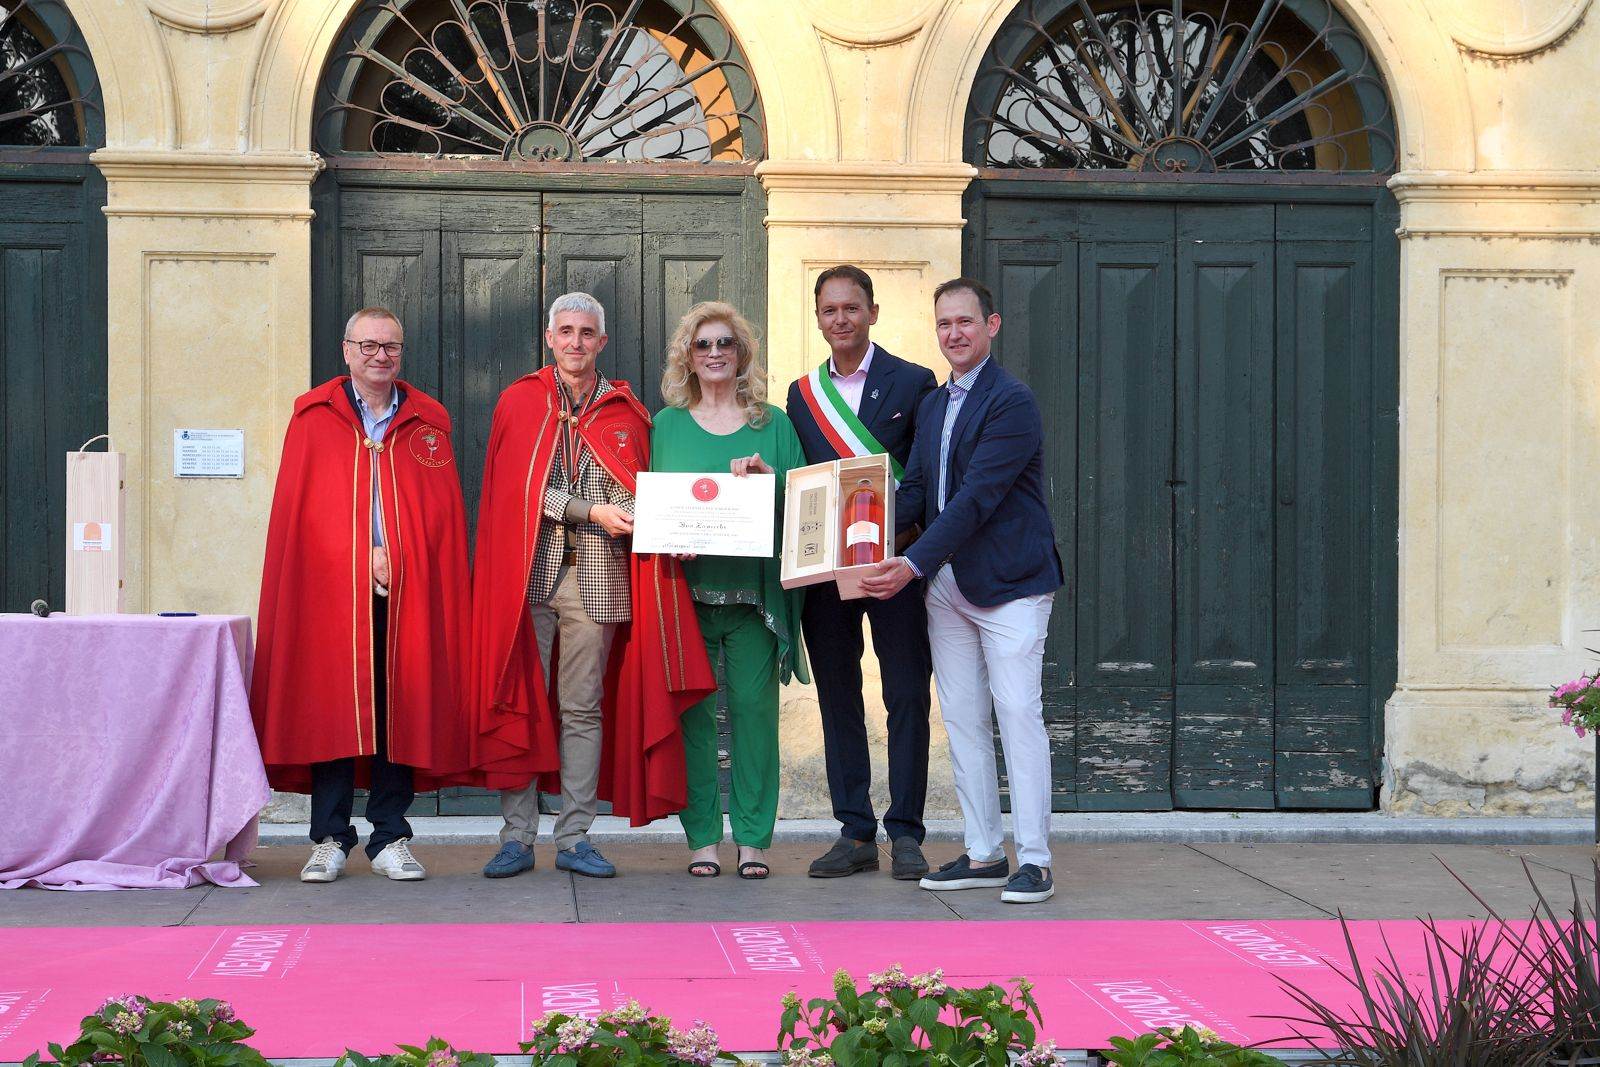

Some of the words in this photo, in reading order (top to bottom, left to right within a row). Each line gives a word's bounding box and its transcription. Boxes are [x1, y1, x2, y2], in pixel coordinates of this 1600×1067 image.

[210, 929, 292, 978] ALEXANDRA
[730, 926, 805, 972] ALEXANDRA
[1093, 980, 1206, 1028] EXANDRA
